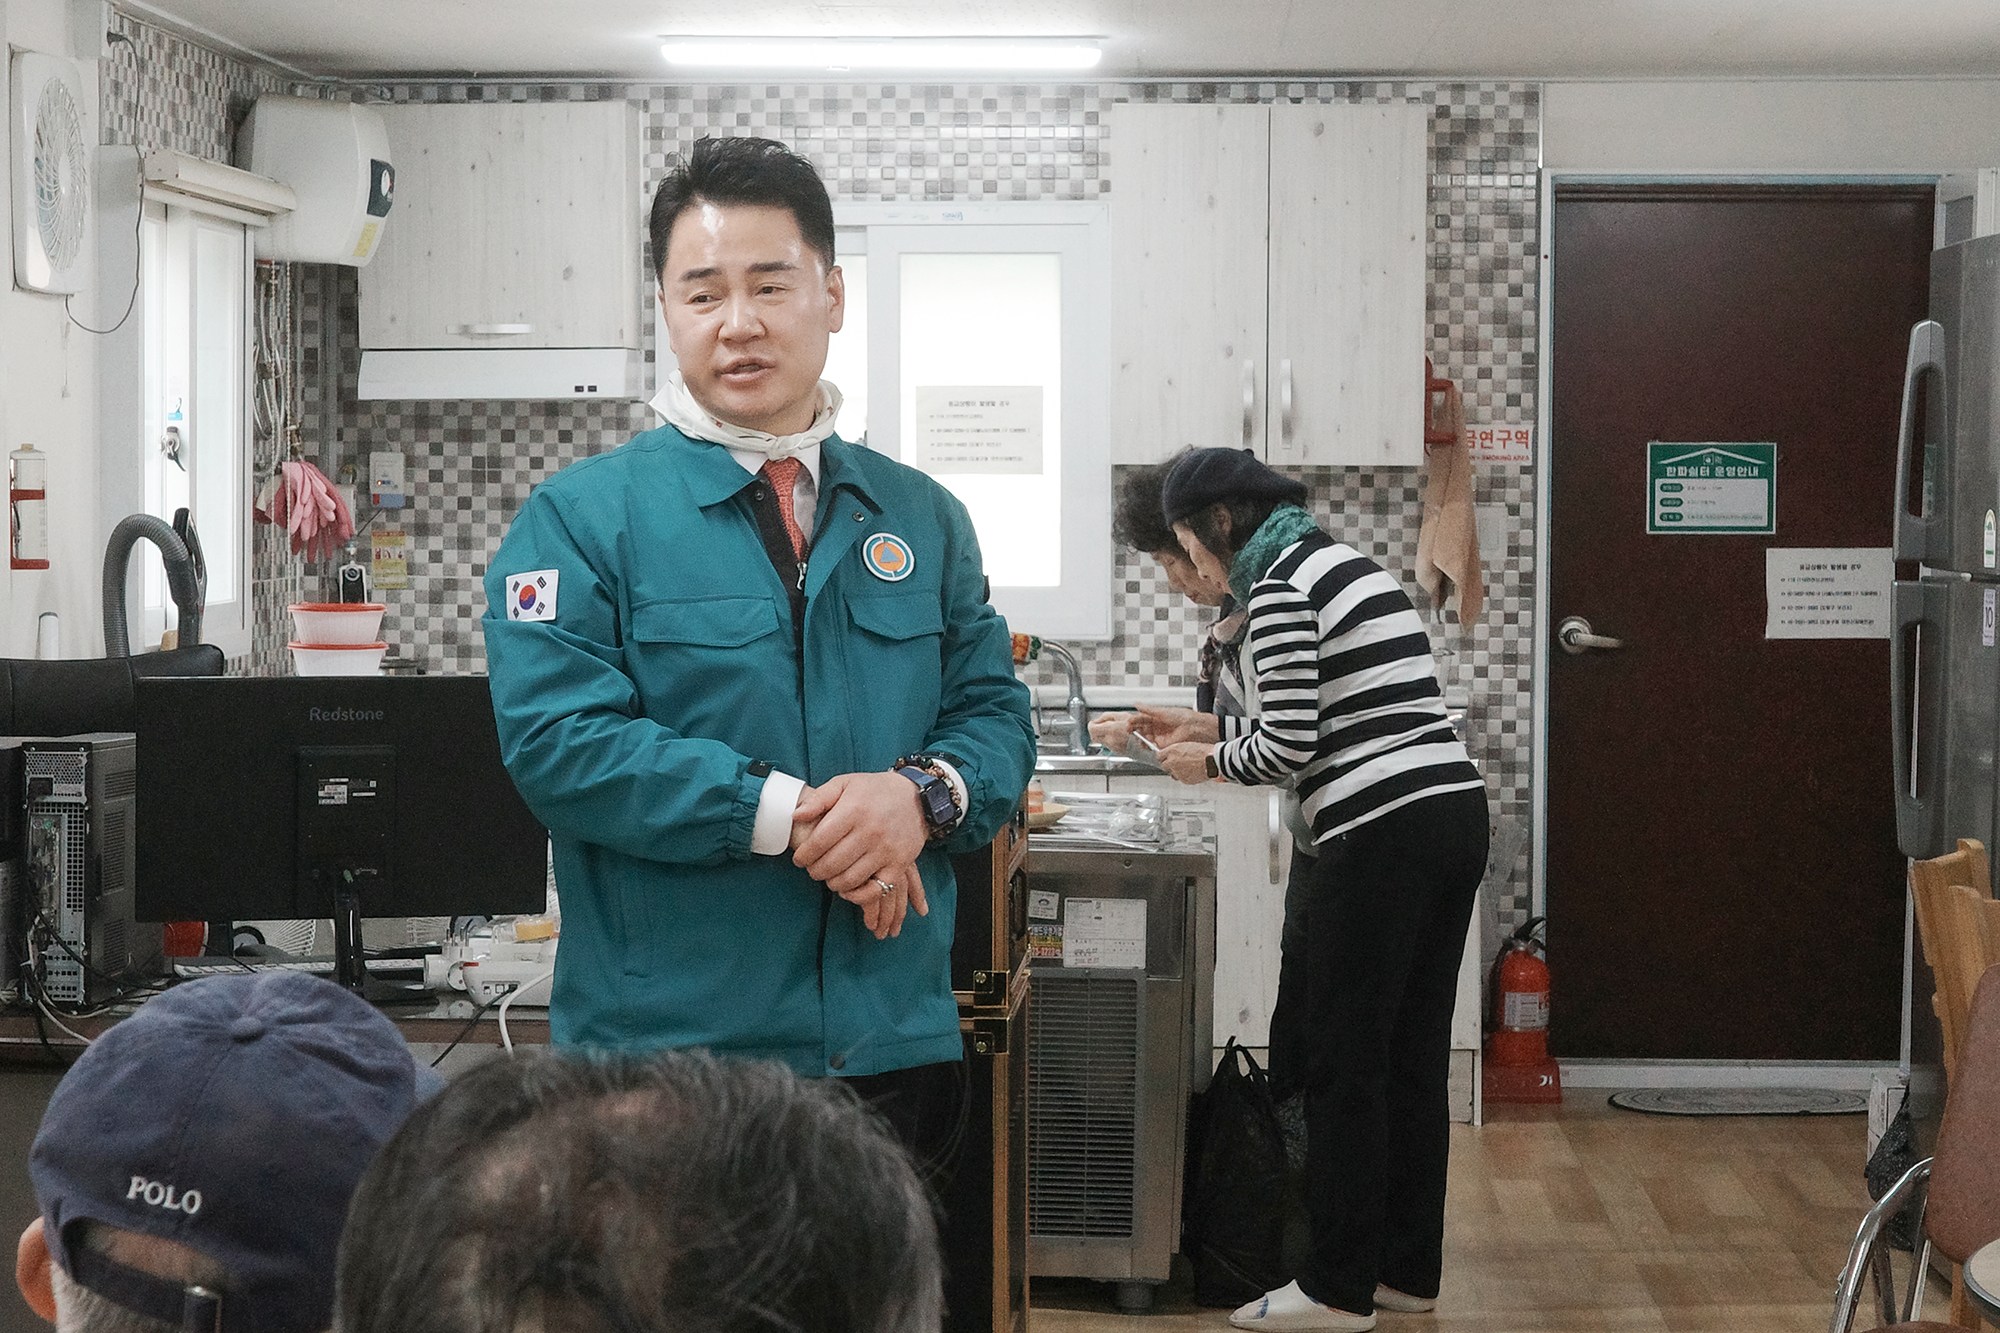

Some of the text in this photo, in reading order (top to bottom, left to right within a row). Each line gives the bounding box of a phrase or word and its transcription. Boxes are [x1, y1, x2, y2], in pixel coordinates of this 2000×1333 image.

[1466, 429, 1529, 450] 금연구역
[1666, 466, 1759, 477] 한파쉼터 운영안내
[309, 706, 385, 722] Redstone
[126, 1174, 203, 1215] POLO
